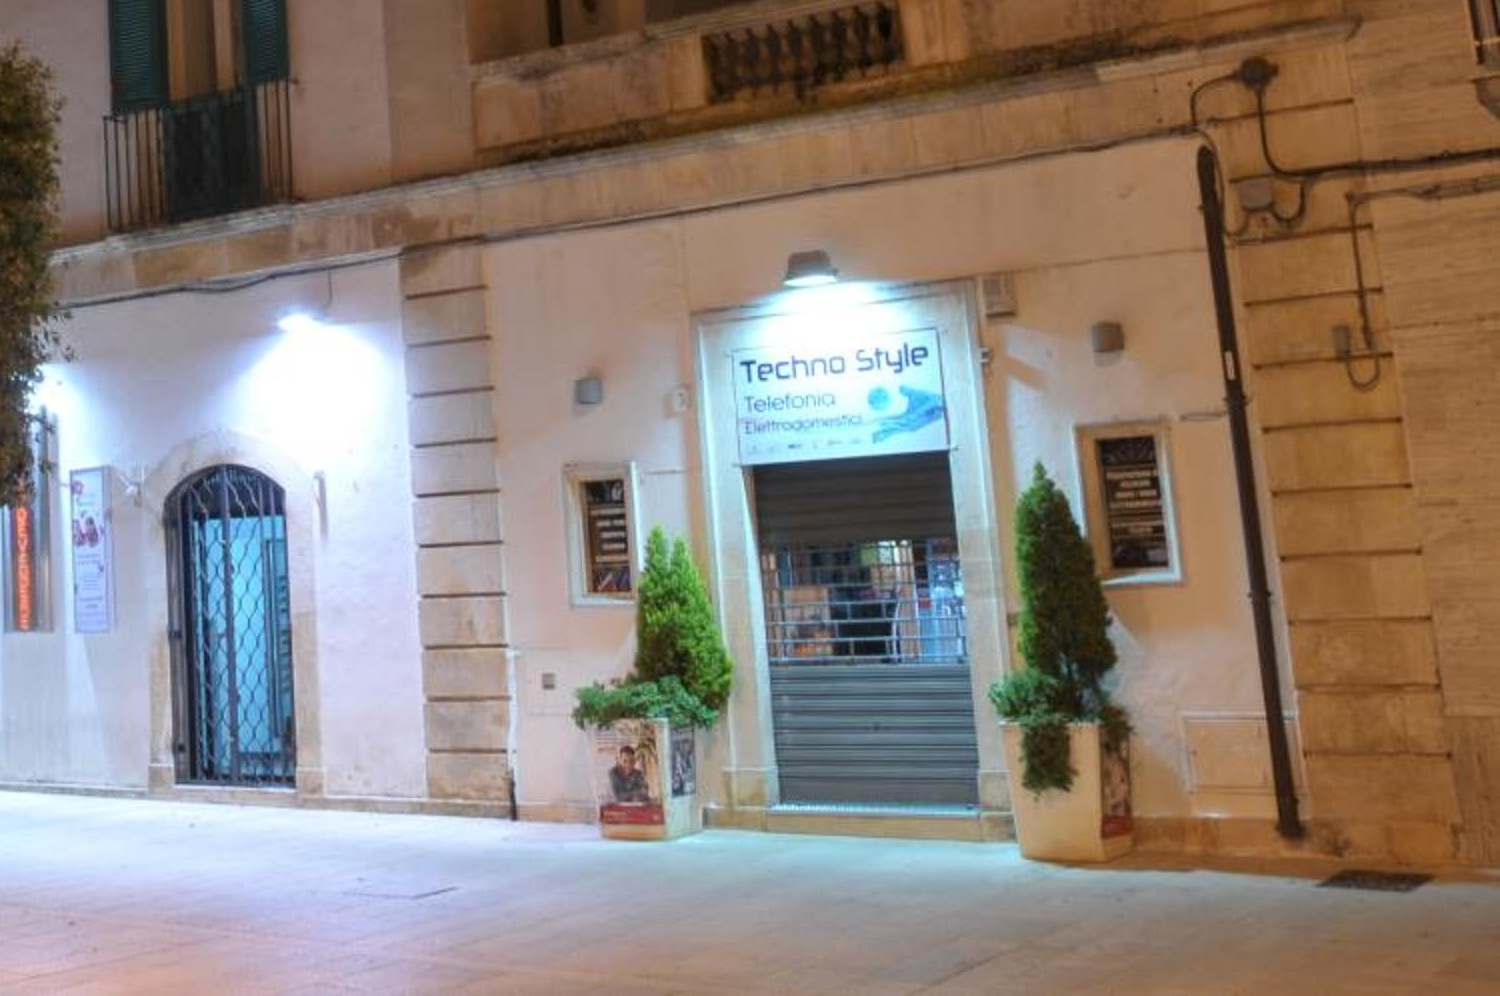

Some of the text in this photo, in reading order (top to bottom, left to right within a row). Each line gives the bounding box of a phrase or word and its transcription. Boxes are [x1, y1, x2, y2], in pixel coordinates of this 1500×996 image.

[740, 342, 929, 384] Techno Style
[744, 391, 836, 413] Telefonia
